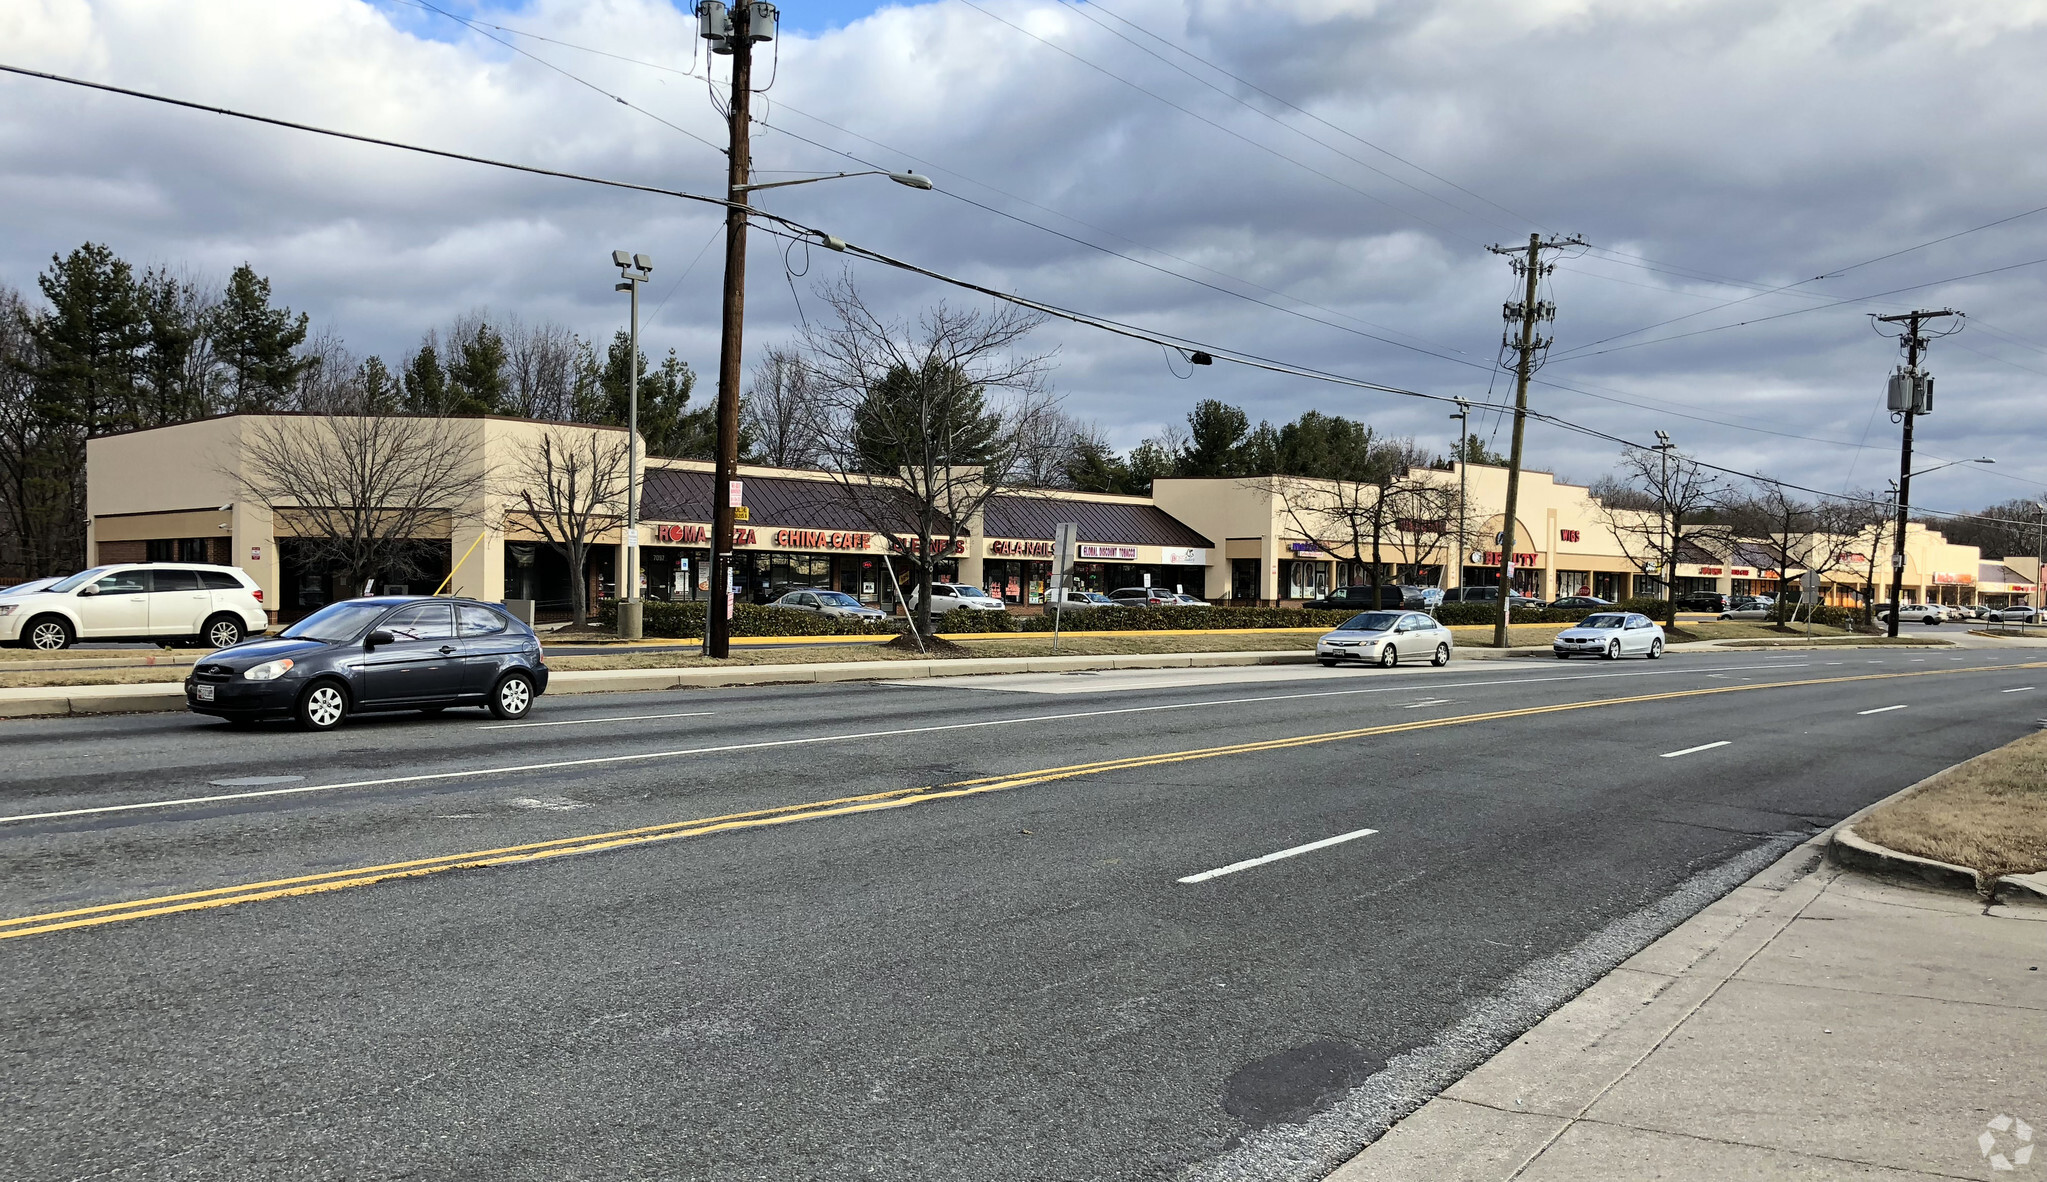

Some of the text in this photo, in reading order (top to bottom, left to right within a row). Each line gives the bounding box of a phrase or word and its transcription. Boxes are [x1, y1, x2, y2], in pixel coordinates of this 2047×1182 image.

[658, 524, 707, 542] ROMA
[778, 530, 870, 549] CHINA CAFE
[1561, 529, 1580, 542] WIGS
[993, 540, 1022, 555] GALA
[1099, 547, 1117, 557] DISCOUNT
[1119, 547, 1136, 558] TOBACCO
[1484, 551, 1538, 567] BEUTY
